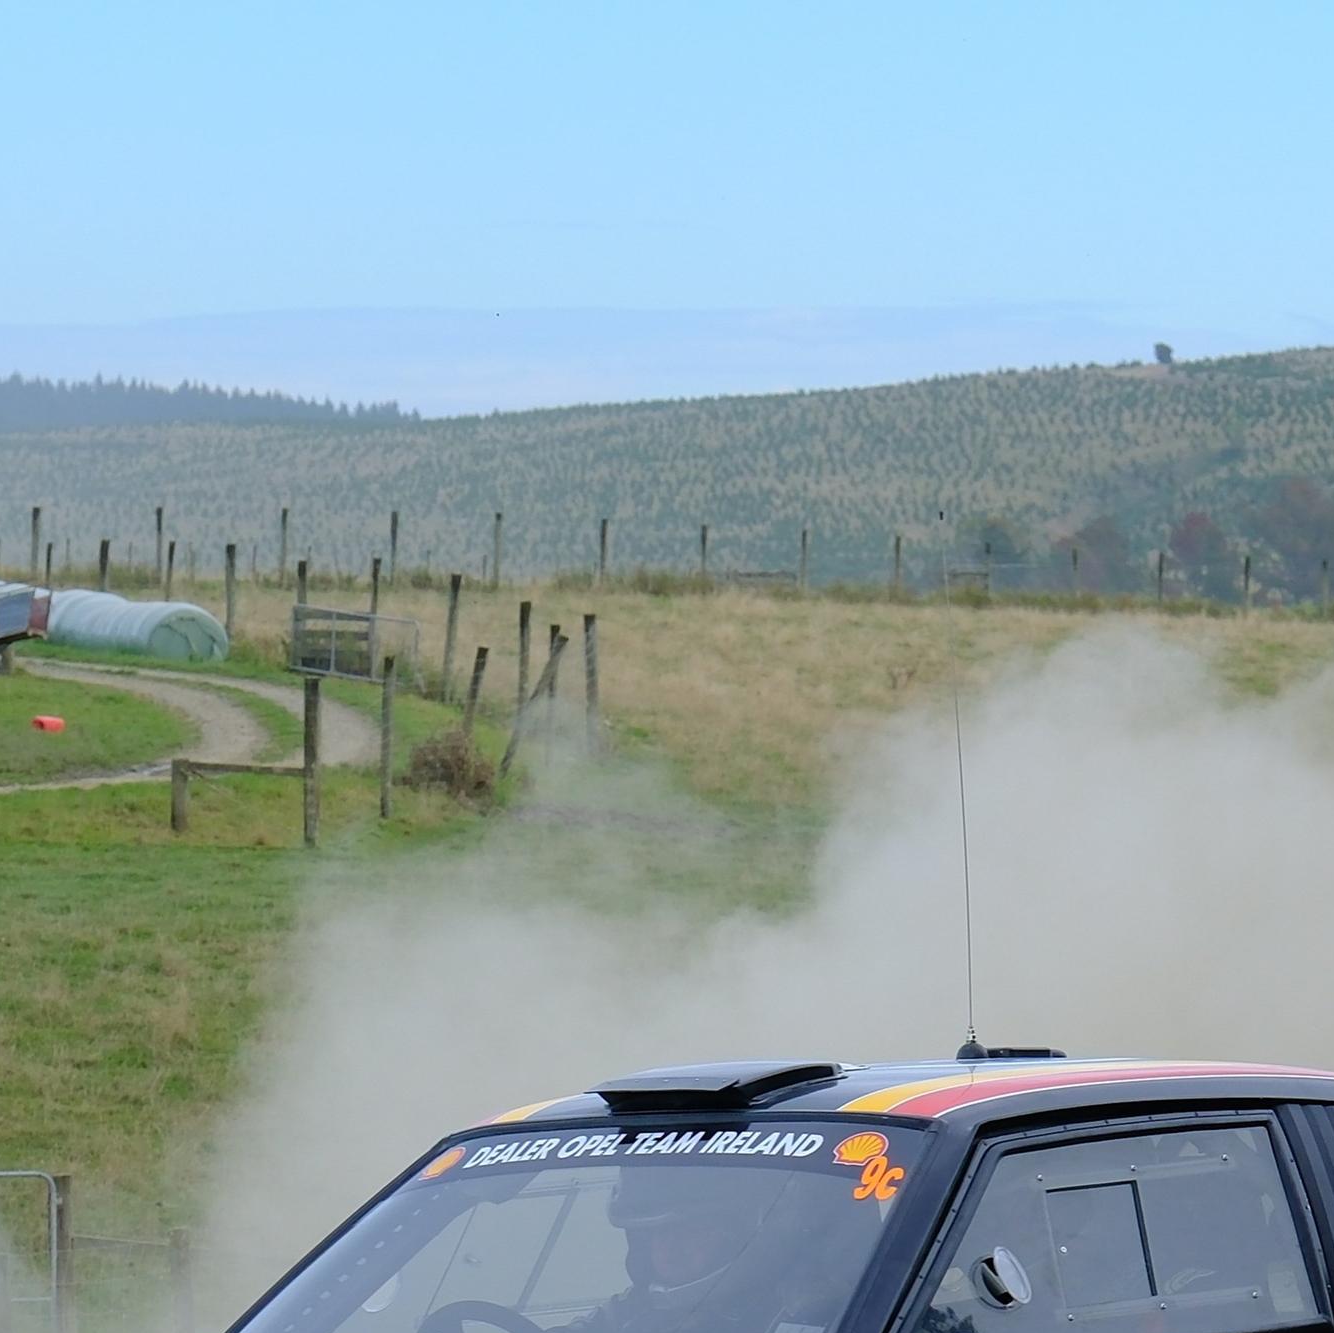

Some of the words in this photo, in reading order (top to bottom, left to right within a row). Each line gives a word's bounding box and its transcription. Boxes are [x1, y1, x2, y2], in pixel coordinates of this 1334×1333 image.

[463, 1138, 560, 1169] DEALER
[556, 1133, 622, 1160] OPEL
[623, 1131, 707, 1156] TEAM
[699, 1131, 825, 1159] IRELAND
